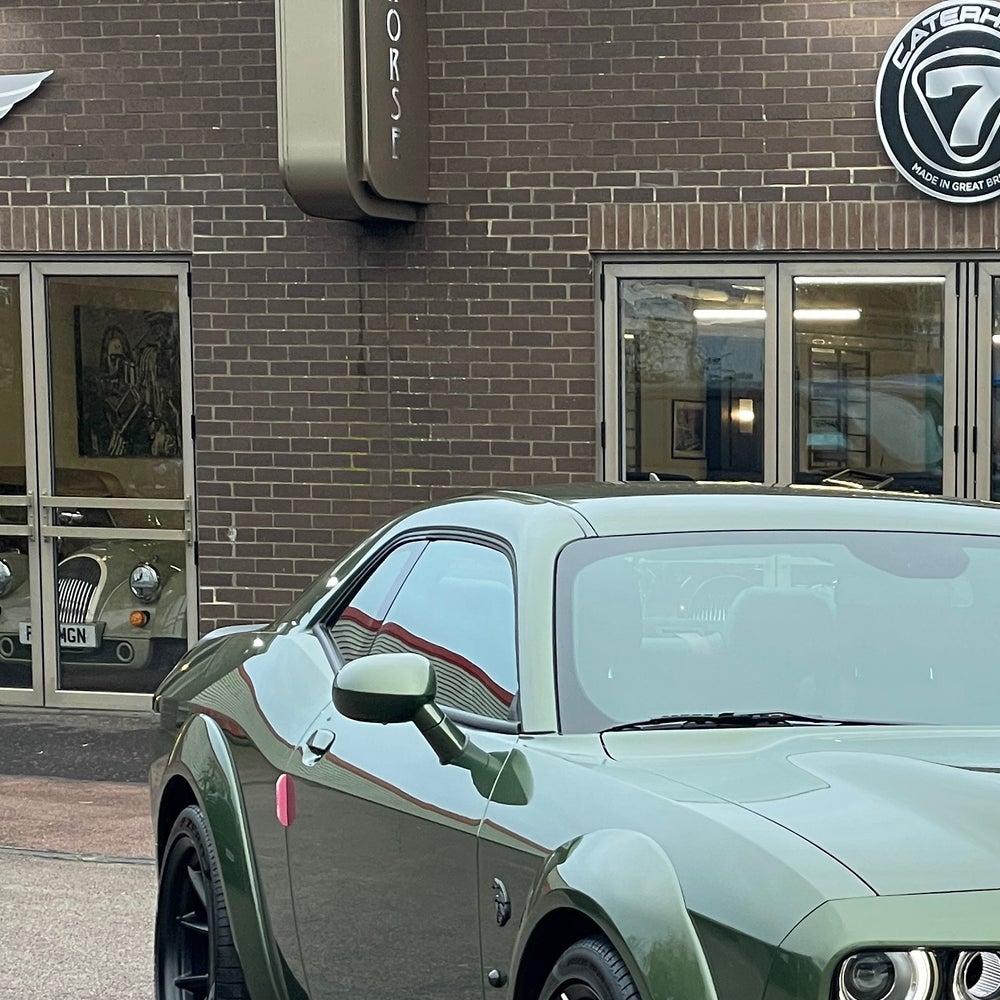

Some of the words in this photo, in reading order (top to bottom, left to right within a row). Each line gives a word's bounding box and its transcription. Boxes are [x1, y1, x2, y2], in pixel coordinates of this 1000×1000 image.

[386, 0, 402, 160] ORSE
[911, 162, 938, 185] MADE
[939, 179, 950, 190] IN
[951, 182, 984, 192] GREAT
